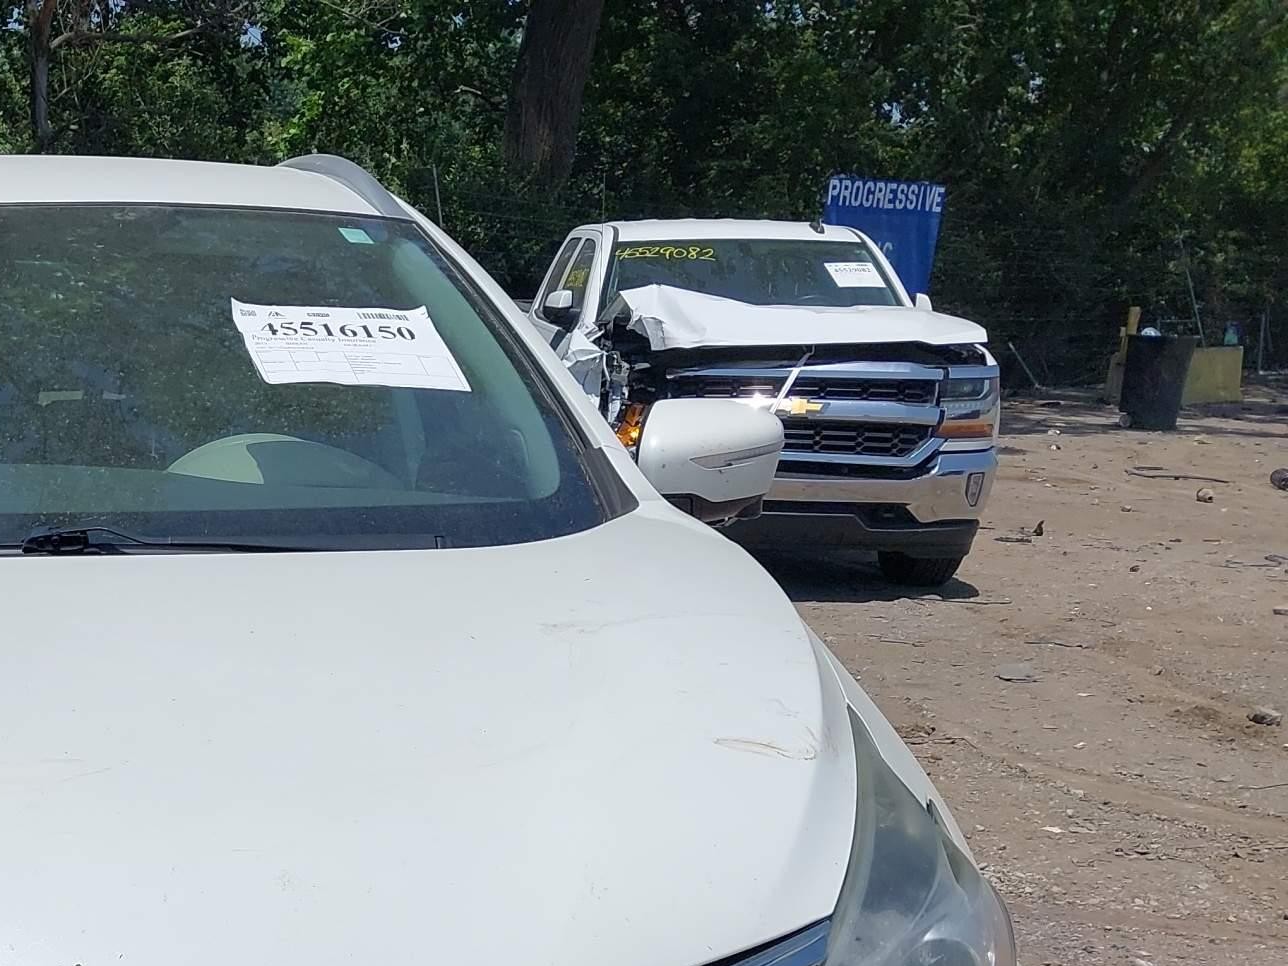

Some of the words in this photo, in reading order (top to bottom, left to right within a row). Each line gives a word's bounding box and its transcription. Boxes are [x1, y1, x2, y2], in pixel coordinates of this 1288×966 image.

[827, 179, 945, 213] PROGRESSIVE
[615, 247, 716, 260] 45529082
[261, 321, 416, 340] 45516150
